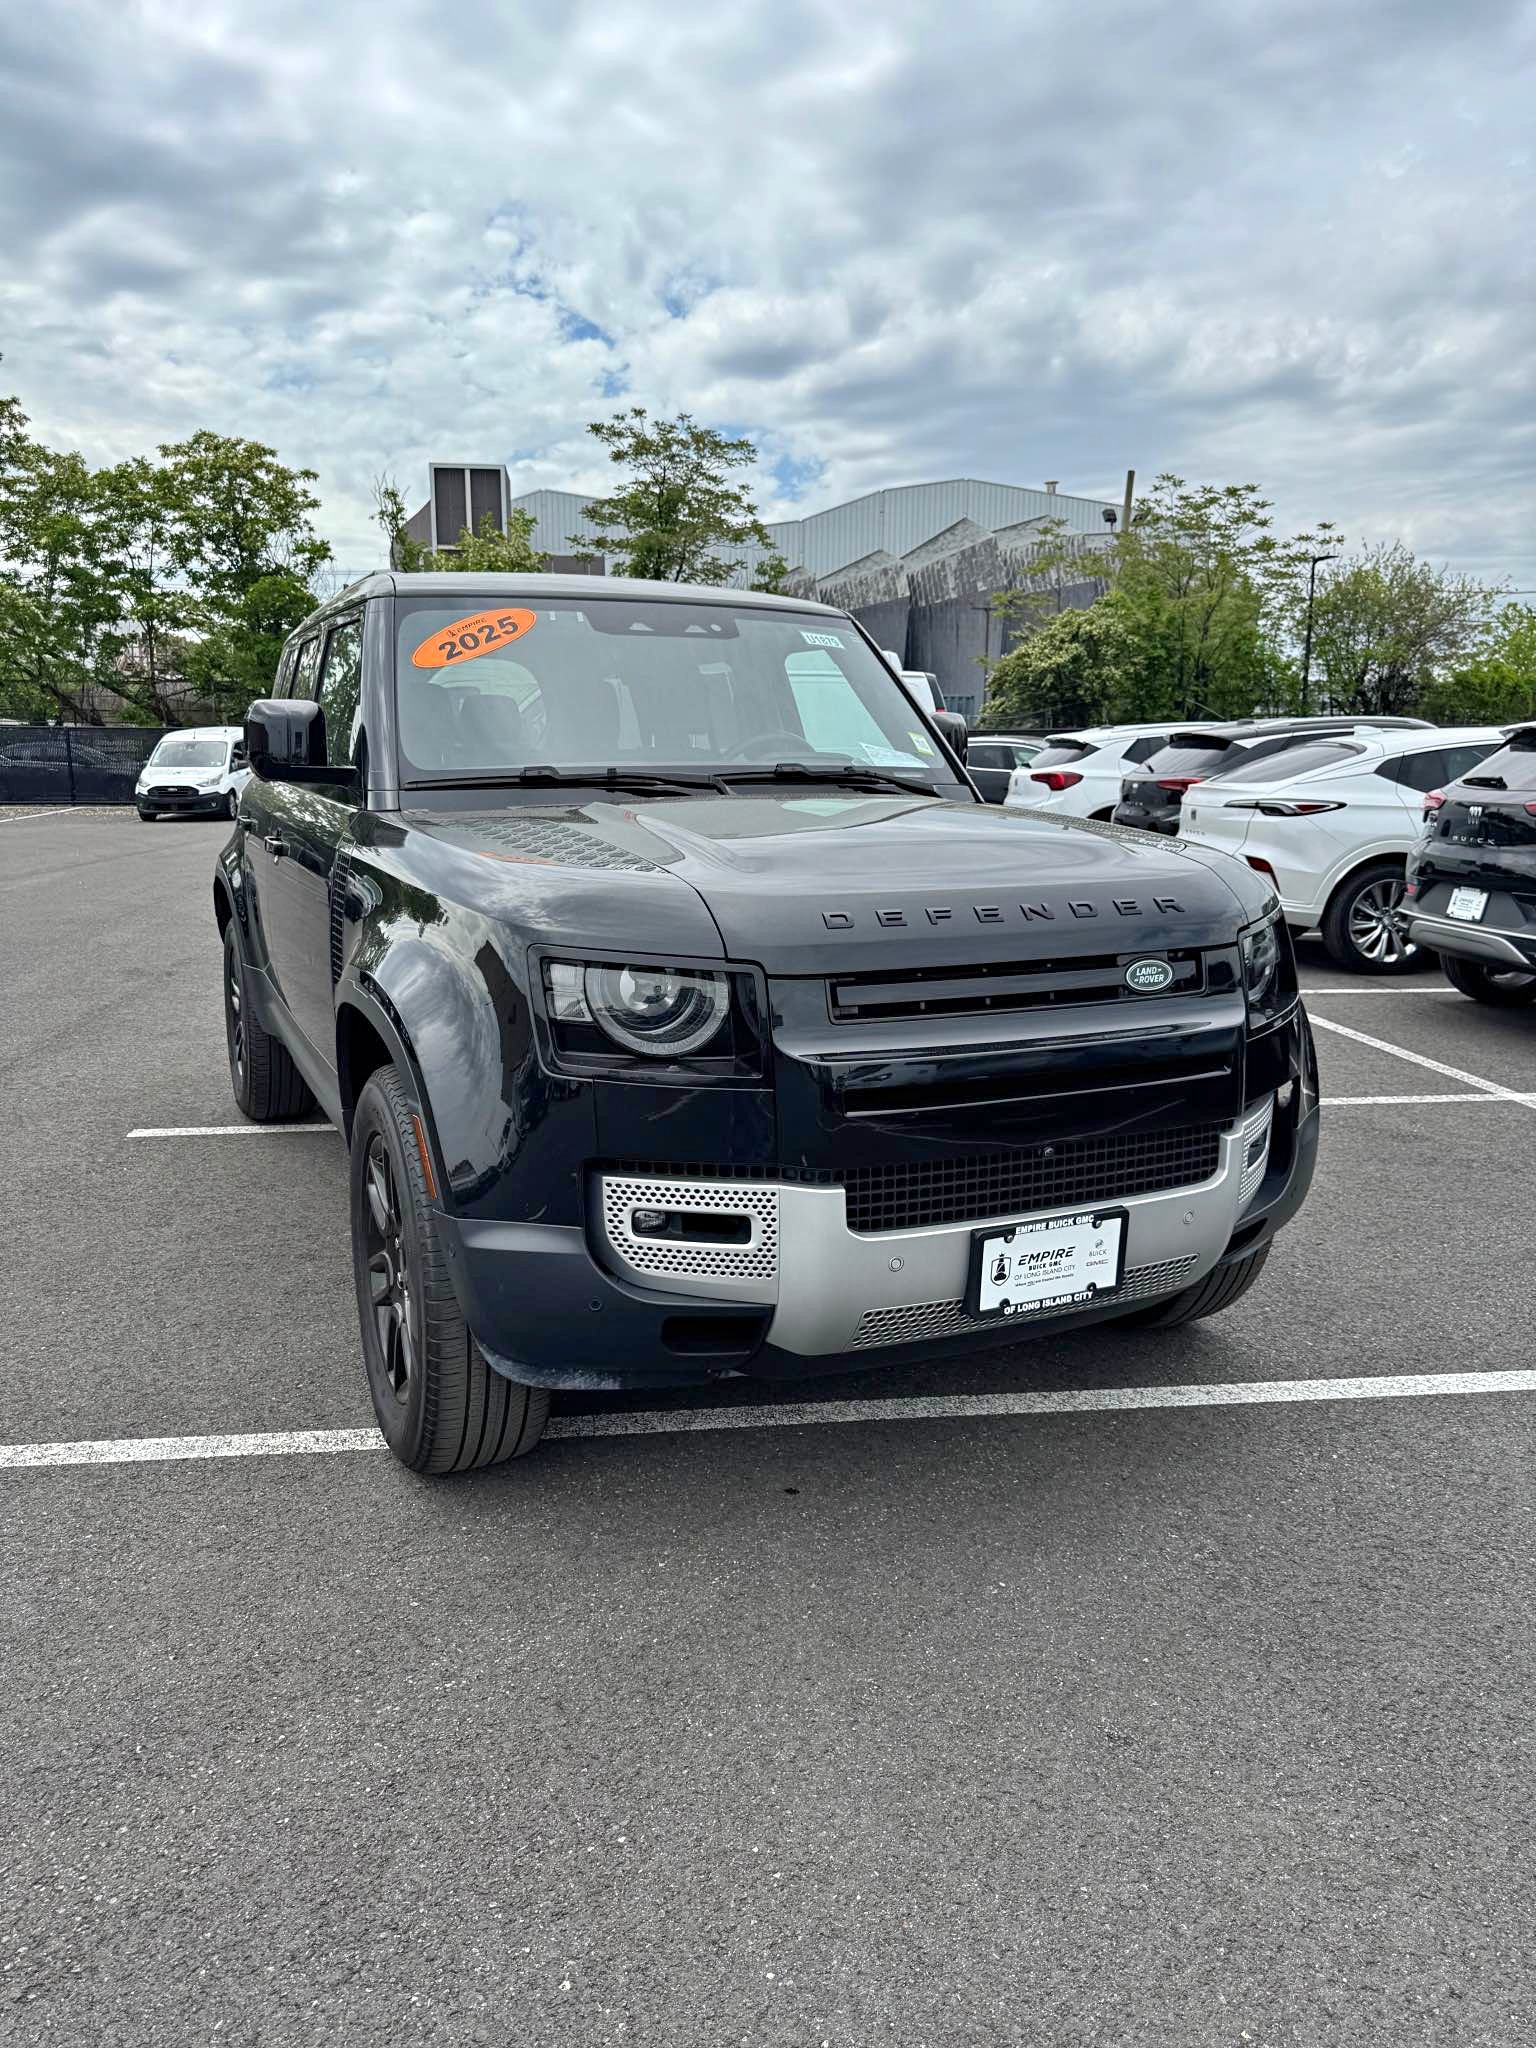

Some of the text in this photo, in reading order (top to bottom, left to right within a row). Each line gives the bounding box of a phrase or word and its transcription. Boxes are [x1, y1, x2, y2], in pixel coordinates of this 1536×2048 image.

[457, 617, 488, 633] EMPIRE
[438, 615, 519, 661] 2025
[822, 896, 1186, 930] DEFENDER
[1015, 1214, 1095, 1235] EMPIRE BUICK GMC
[1018, 1246, 1076, 1266] EMPIRE
[1089, 1249, 1107, 1257] BUICK
[1024, 1270, 1041, 1280] LONG
[1042, 1267, 1063, 1277] ISLAND
[1063, 1264, 1076, 1272] CITY
[1028, 1260, 1062, 1271] BUICK GMC
[1004, 1291, 1094, 1315] OF LONG ISLAND CITY
